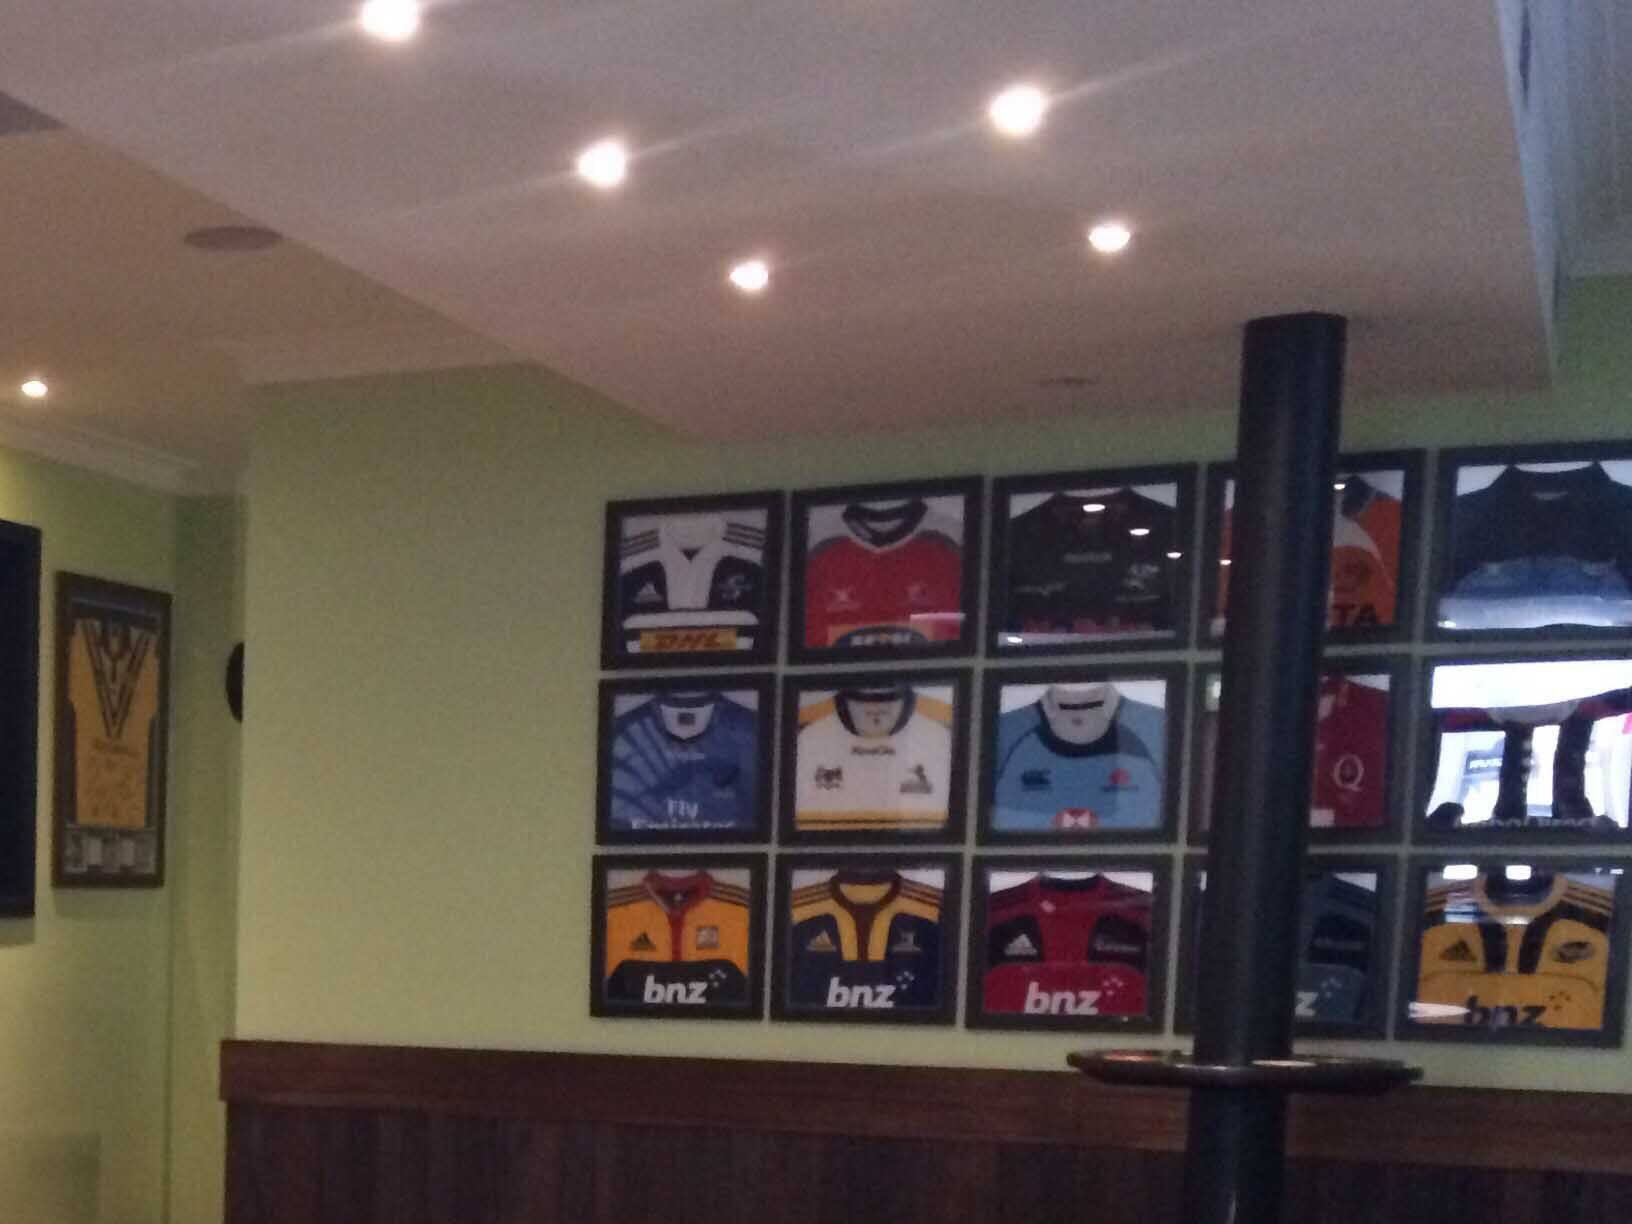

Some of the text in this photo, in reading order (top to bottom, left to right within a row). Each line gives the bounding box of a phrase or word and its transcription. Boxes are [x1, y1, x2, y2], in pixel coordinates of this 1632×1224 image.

[643, 974, 708, 1004] bnz
[826, 976, 896, 1008] bnz
[1024, 981, 1101, 1015] bnz
[1464, 995, 1547, 1026] bnz
